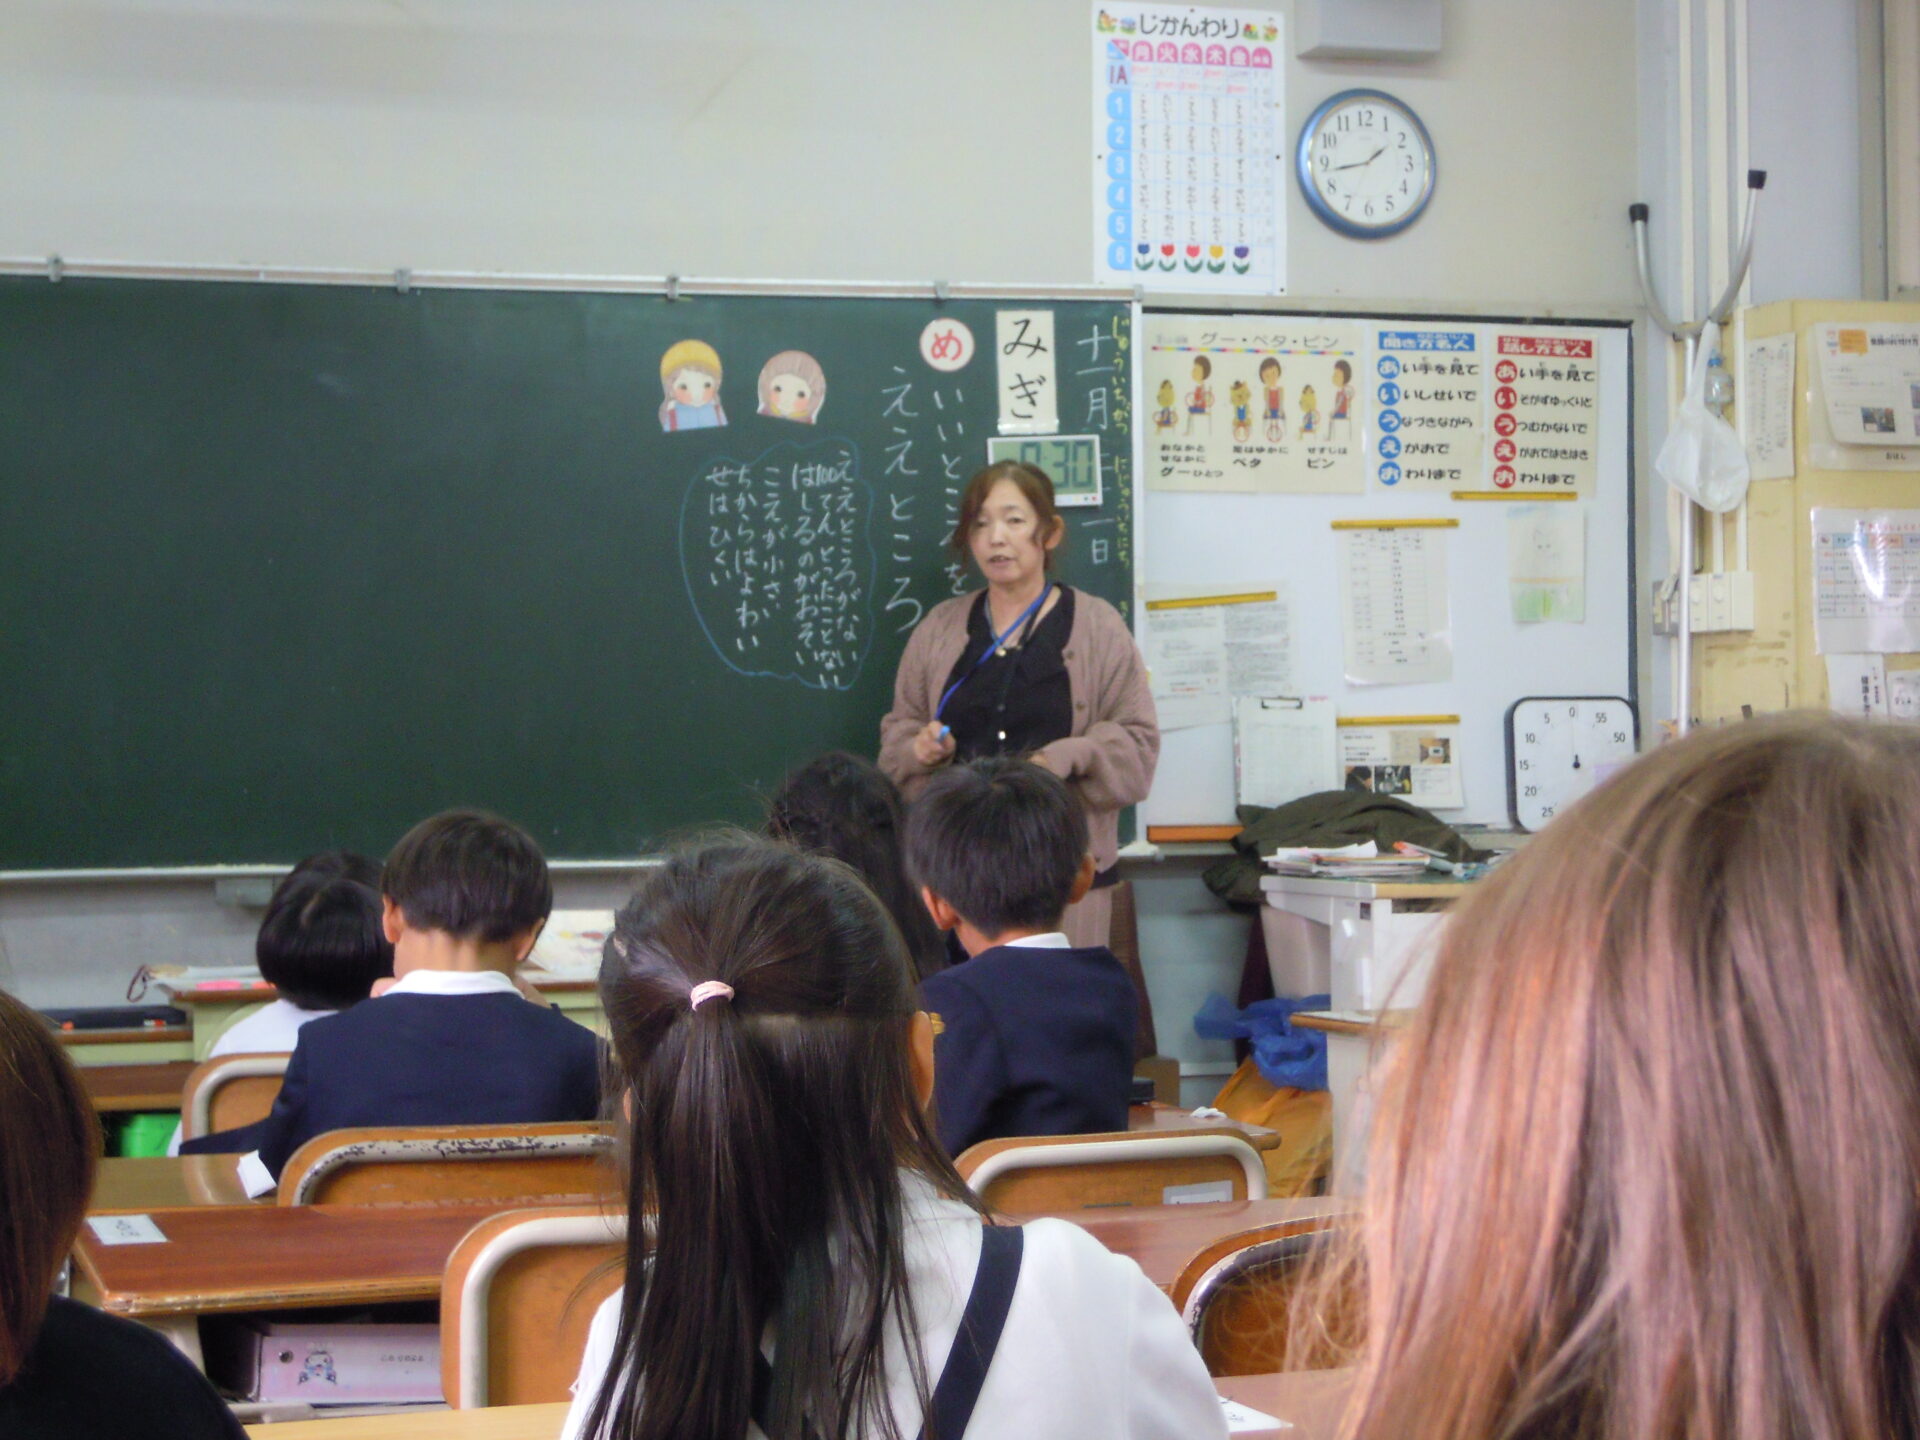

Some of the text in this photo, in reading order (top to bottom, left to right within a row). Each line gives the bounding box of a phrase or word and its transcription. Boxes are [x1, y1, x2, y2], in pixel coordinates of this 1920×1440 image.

[1140, 13, 1239, 39] じかんわり
[1160, 46, 1176, 62] 火
[1184, 47, 1201, 63] 水
[1208, 49, 1224, 64] 木
[1337, 115, 1350, 132] 11
[1358, 110, 1373, 127] 12
[1383, 115, 1389, 132] 1
[1323, 133, 1337, 149] 10
[1397, 132, 1407, 149] 2
[1320, 155, 1329, 172] 9
[1404, 155, 1414, 172] 3
[1328, 178, 1337, 195] 8
[1400, 179, 1408, 195] 4
[1344, 195, 1352, 211] 7
[1364, 200, 1374, 217] 6
[1385, 195, 1394, 212] 5
[931, 329, 963, 361] め
[1003, 318, 1048, 419] みぎ
[881, 366, 921, 634] ええところ
[706, 466, 733, 586] せはひくい
[734, 465, 759, 651] ちからはよわい
[1543, 712, 1551, 724] 5
[1568, 706, 1576, 718] 0
[1595, 712, 1607, 723] 55
[1525, 733, 1536, 743] 10
[1613, 732, 1626, 743] 50
[1518, 760, 1529, 770] 15
[1524, 786, 1537, 797] 20
[1541, 807, 1554, 817] 25
